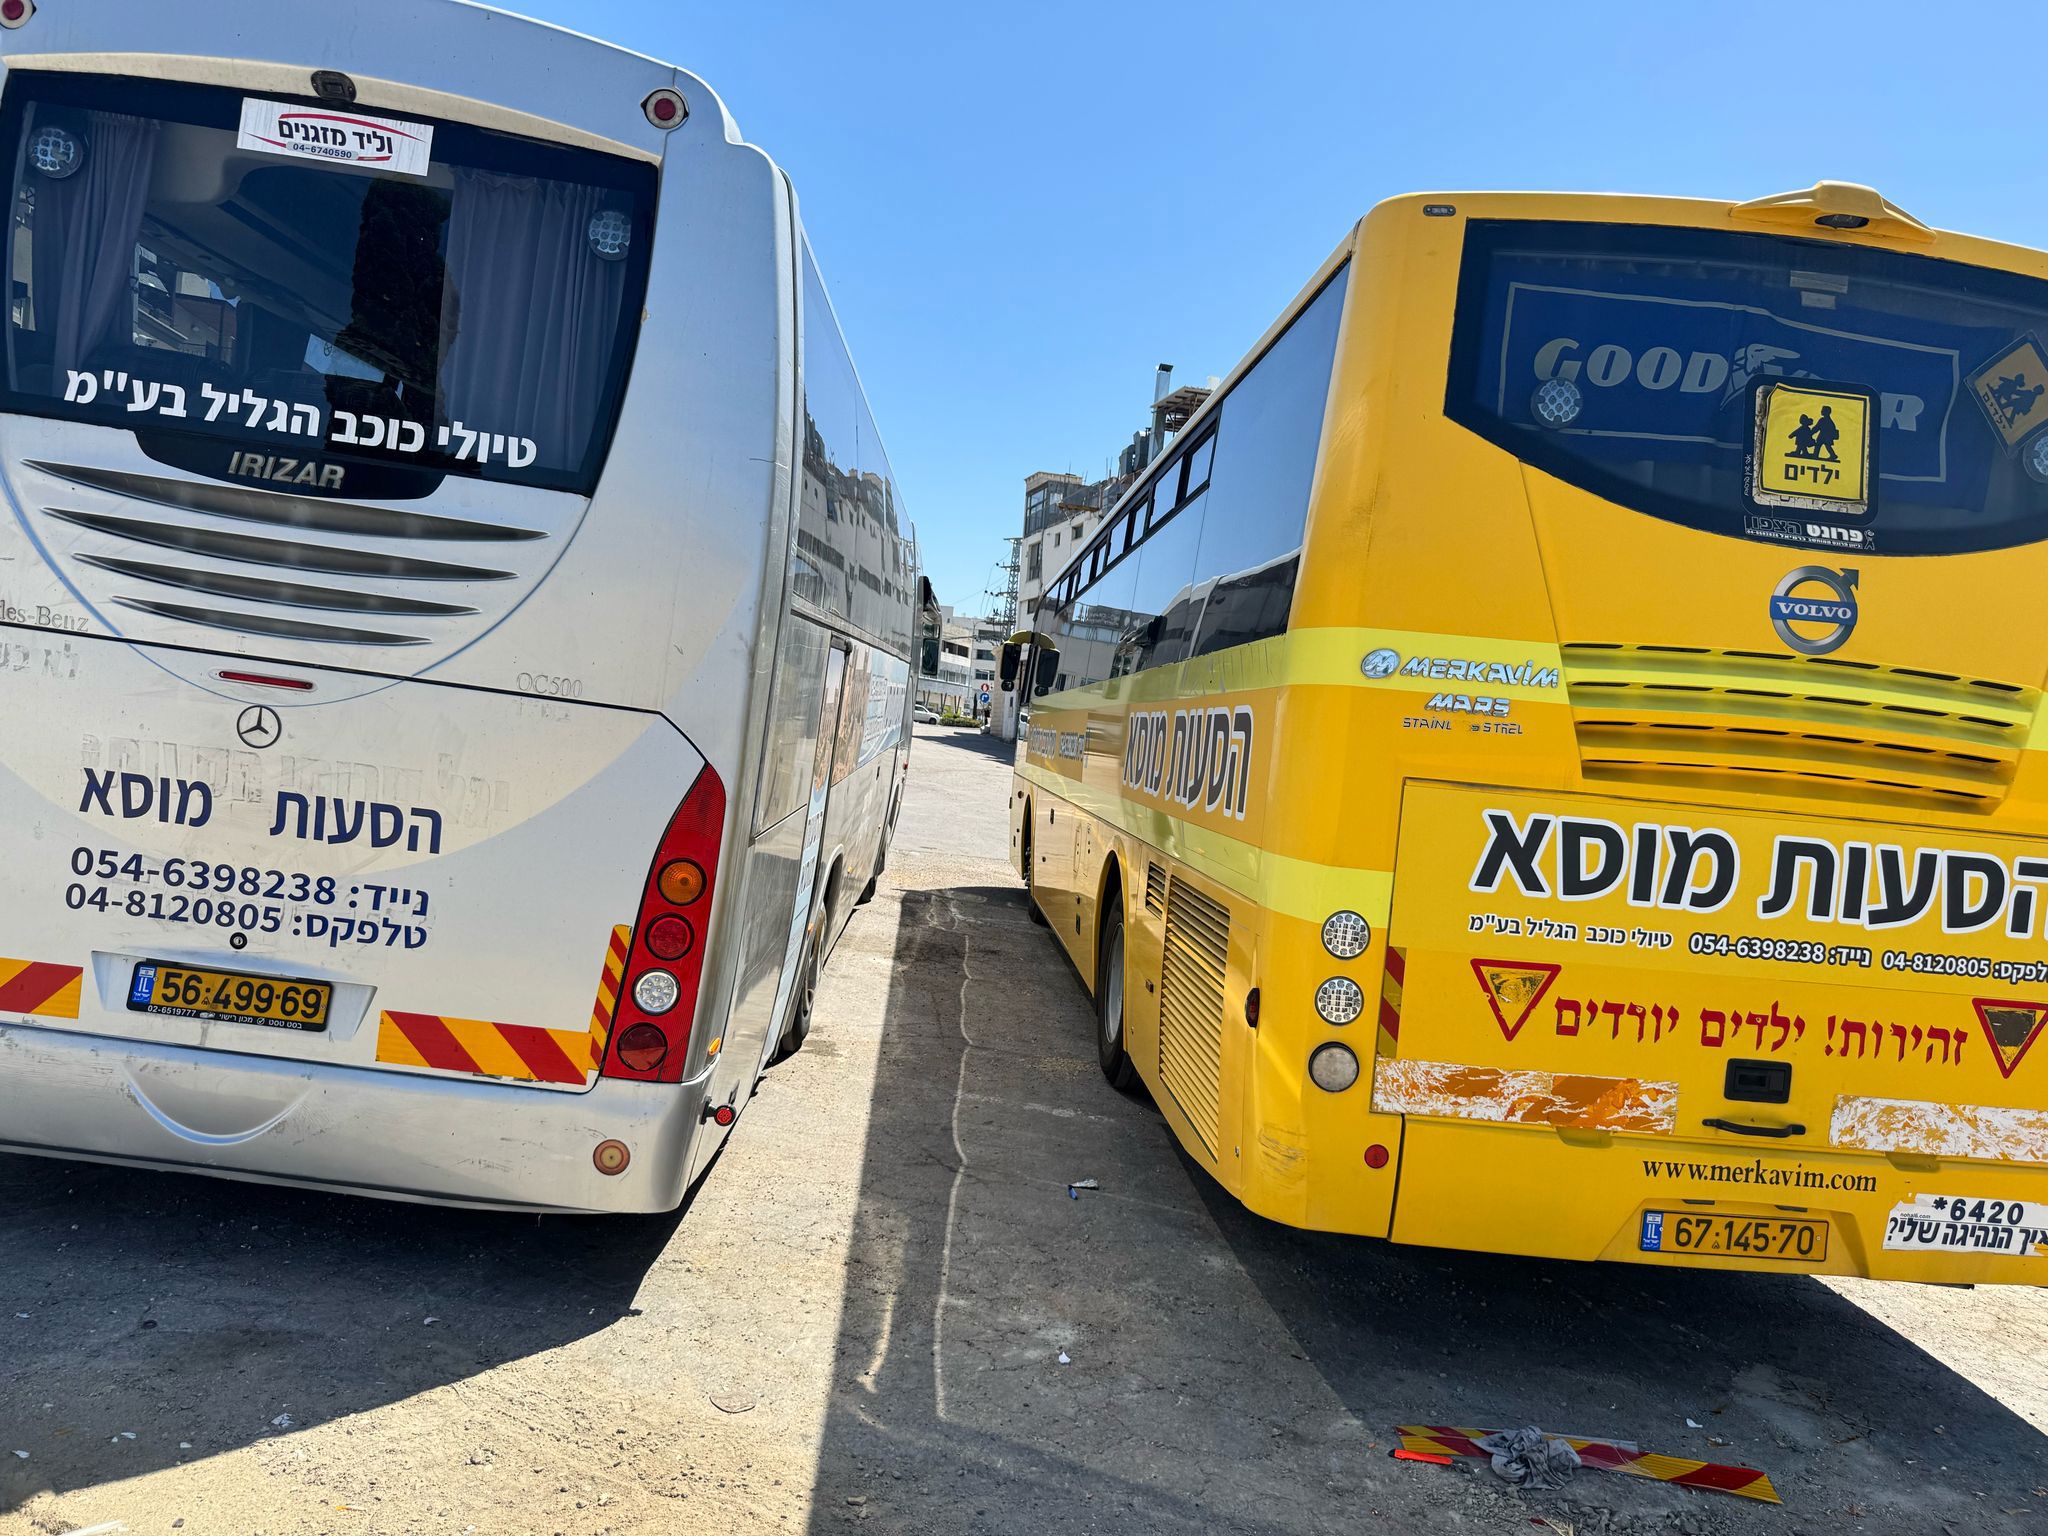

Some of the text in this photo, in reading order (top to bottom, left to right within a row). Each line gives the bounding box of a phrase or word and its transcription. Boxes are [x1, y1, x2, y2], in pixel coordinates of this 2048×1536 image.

[278, 119, 394, 154] וליד מזגנים
[292, 142, 353, 159] 04-6740590
[201, 382, 321, 438] הגליל
[331, 410, 425, 453] כוכב
[437, 420, 538, 468] טיולי
[227, 451, 346, 490] IRIZAR
[1783, 464, 1840, 485] ילדים
[1806, 523, 1863, 543] פרונט
[1776, 602, 1852, 619] VOLVO
[516, 672, 583, 698] OC500
[1424, 692, 1511, 718] MARS
[1122, 704, 1254, 822] הסעות מוסא
[79, 766, 213, 828] מוסא
[268, 790, 443, 855] הסעות
[70, 846, 430, 917] נייד: 054-6398238
[1468, 808, 2048, 942] הסעות מוסא
[64, 882, 428, 949] טלפקס: 04-8120805
[1526, 917, 1577, 941] הגליל
[1586, 924, 1626, 944] כוכב
[1630, 927, 1673, 949] טיולי
[1688, 932, 1873, 968] נייד: 054-6398238
[1881, 951, 2048, 984] לפקס: 04-8120805
[138, 977, 150, 992] IL
[147, 1004, 197, 1018] 02-6519777
[1554, 995, 1969, 1067] זהירות! ילדים יורדים
[1642, 1158, 1877, 1192] www.merkavim.com
[1647, 1223, 1658, 1238] IL
[1887, 1216, 1941, 1244] שלי?
[1941, 1222, 2013, 1250] הנהיגה
